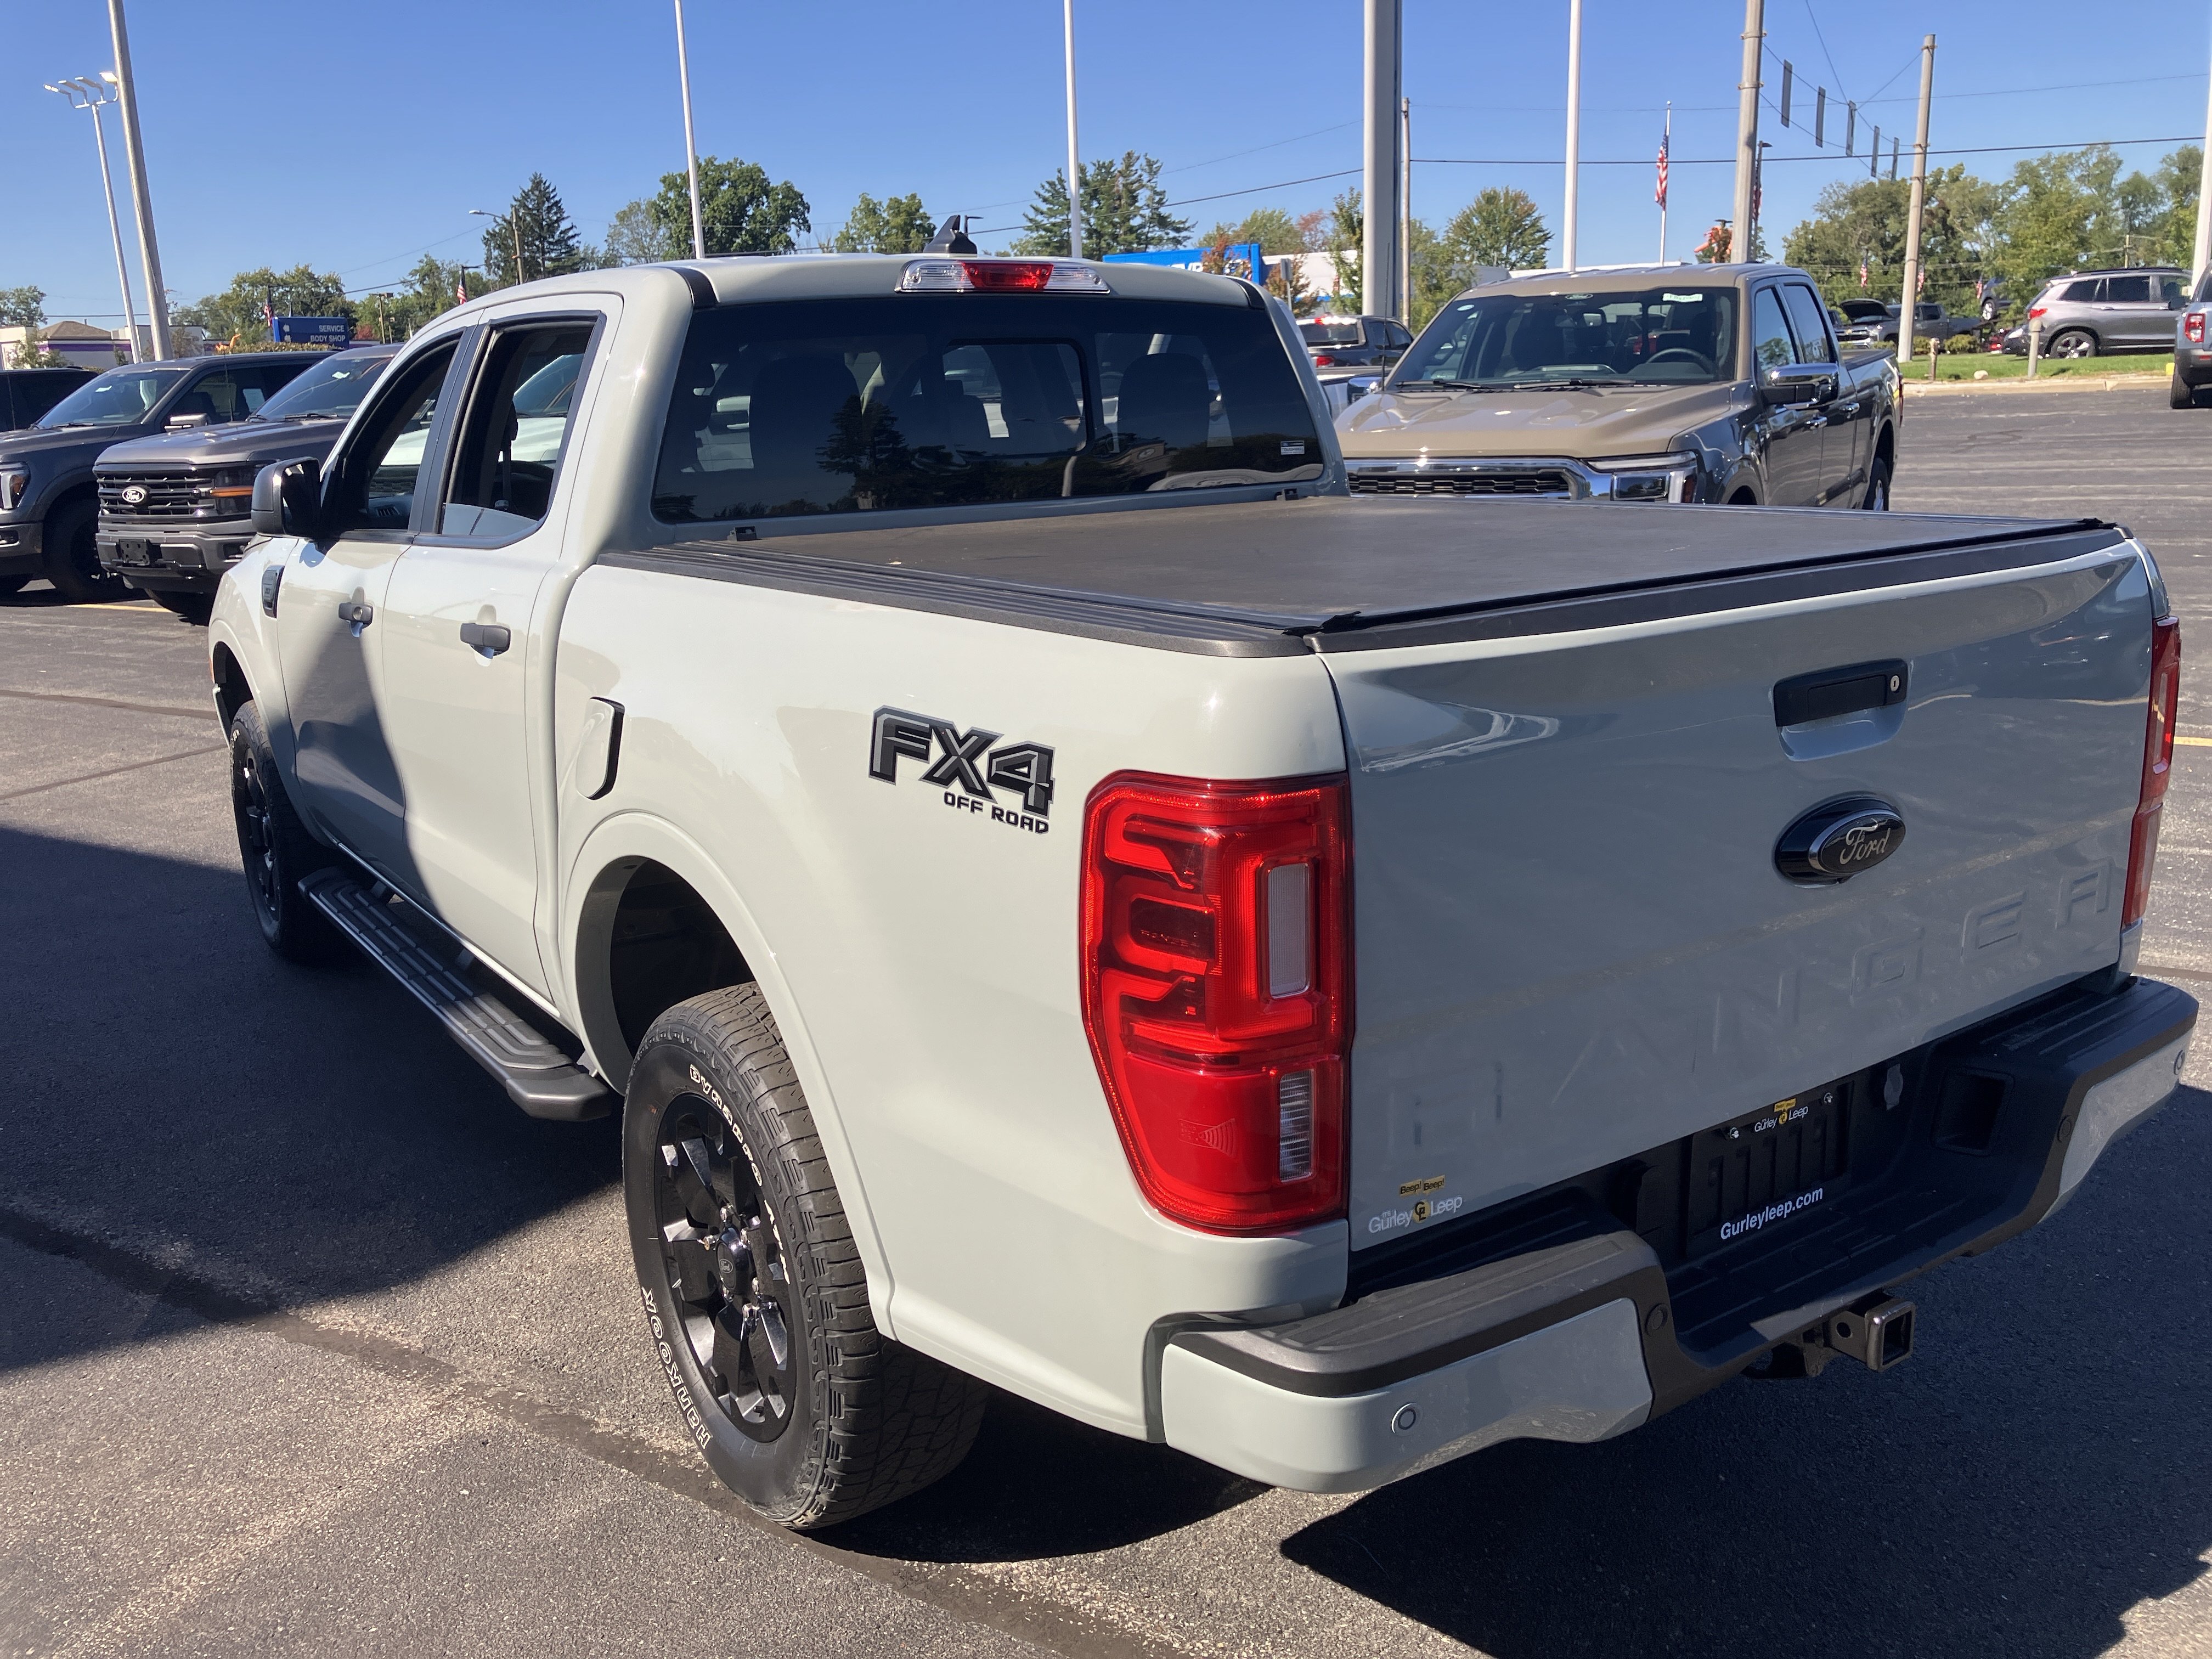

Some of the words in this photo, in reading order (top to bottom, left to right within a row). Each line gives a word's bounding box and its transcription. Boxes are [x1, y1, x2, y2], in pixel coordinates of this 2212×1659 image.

[868, 704, 1056, 820] FX4
[943, 790, 984, 814] OFF
[991, 804, 1050, 835] ROAD
[1839, 823, 1892, 865] Ford
[1788, 1106, 1809, 1120] Leep
[1400, 1181, 1422, 1195] Beep!
[1423, 1178, 1445, 1192] Beep!
[1368, 1209, 1413, 1234] Gurley
[1430, 1195, 1463, 1216] Leep
[1720, 1188, 1824, 1240] Gurleyleep.com
